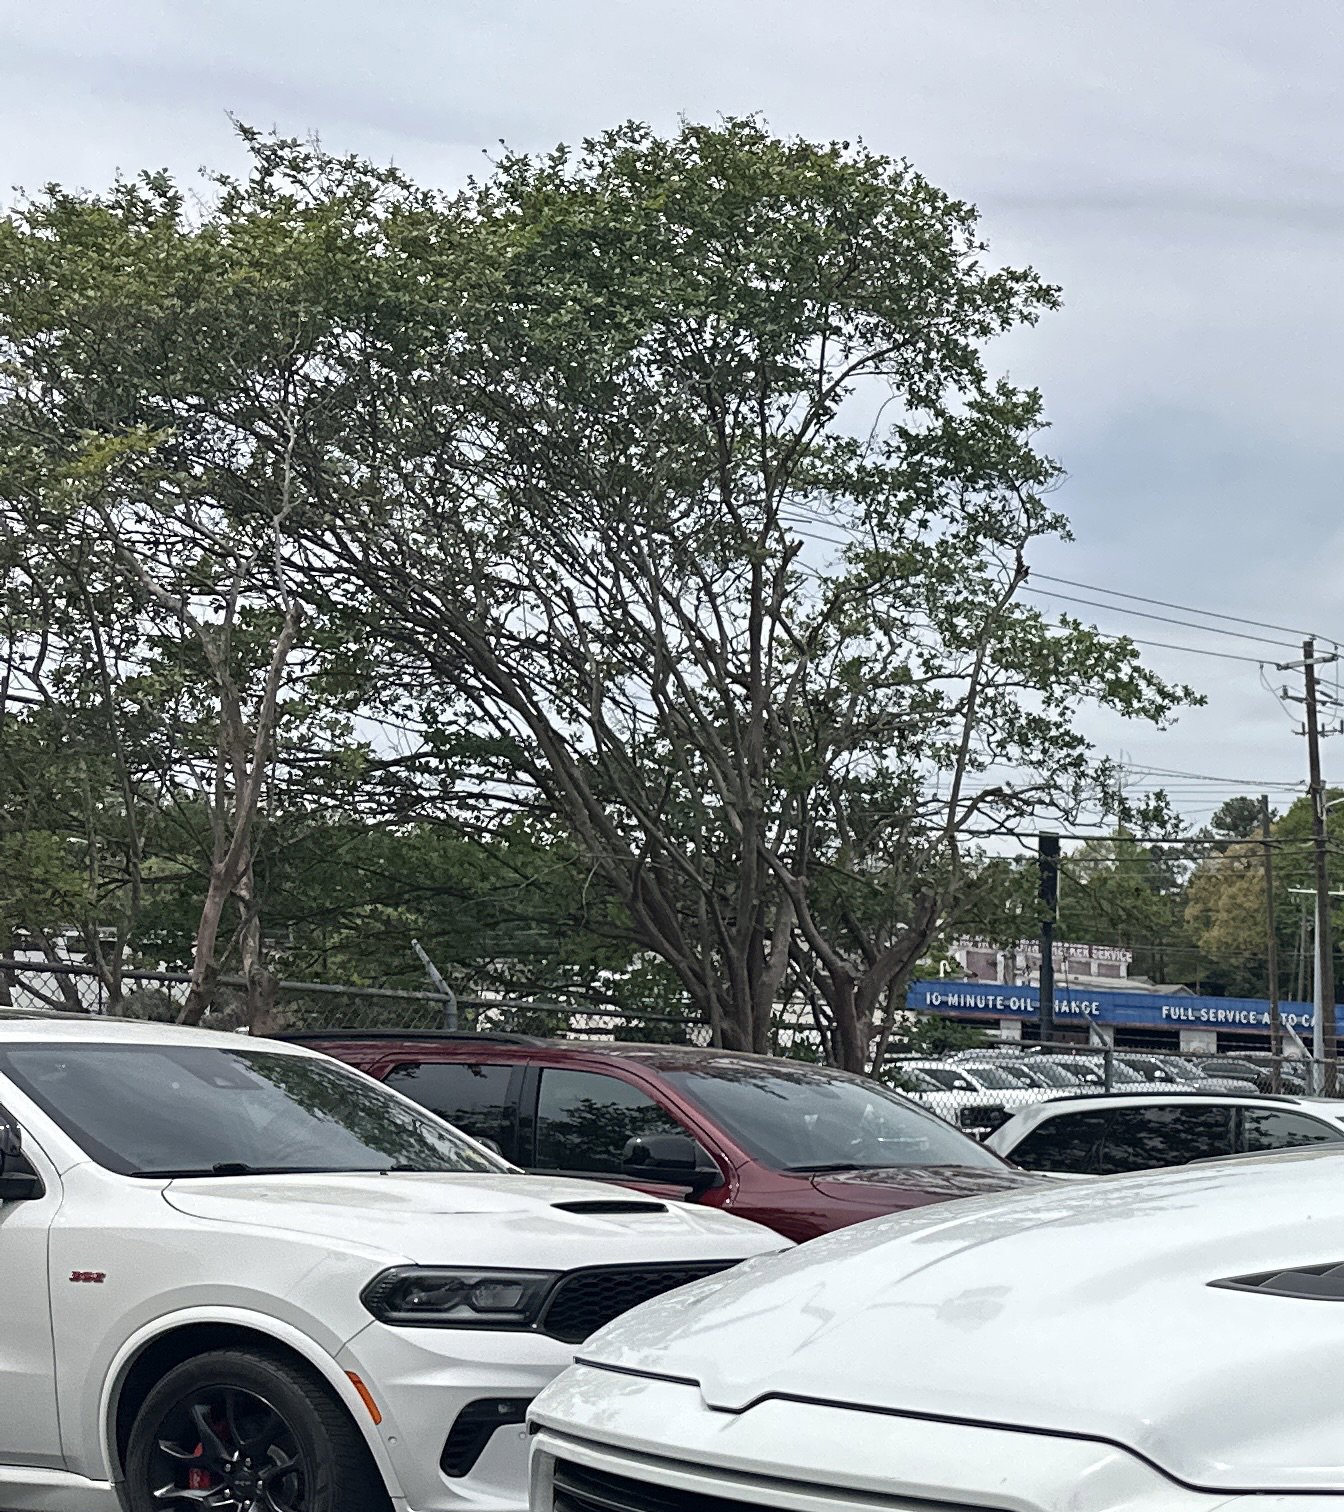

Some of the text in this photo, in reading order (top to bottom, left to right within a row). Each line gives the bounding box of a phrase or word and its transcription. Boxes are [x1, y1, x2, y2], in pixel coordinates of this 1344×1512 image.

[925, 991, 1100, 1015] 10 MINUTE OIL HANGE
[1161, 1005, 1195, 1021] FULL
[1200, 1008, 1257, 1025] SERVICE
[1262, 1012, 1297, 1027] ATO
